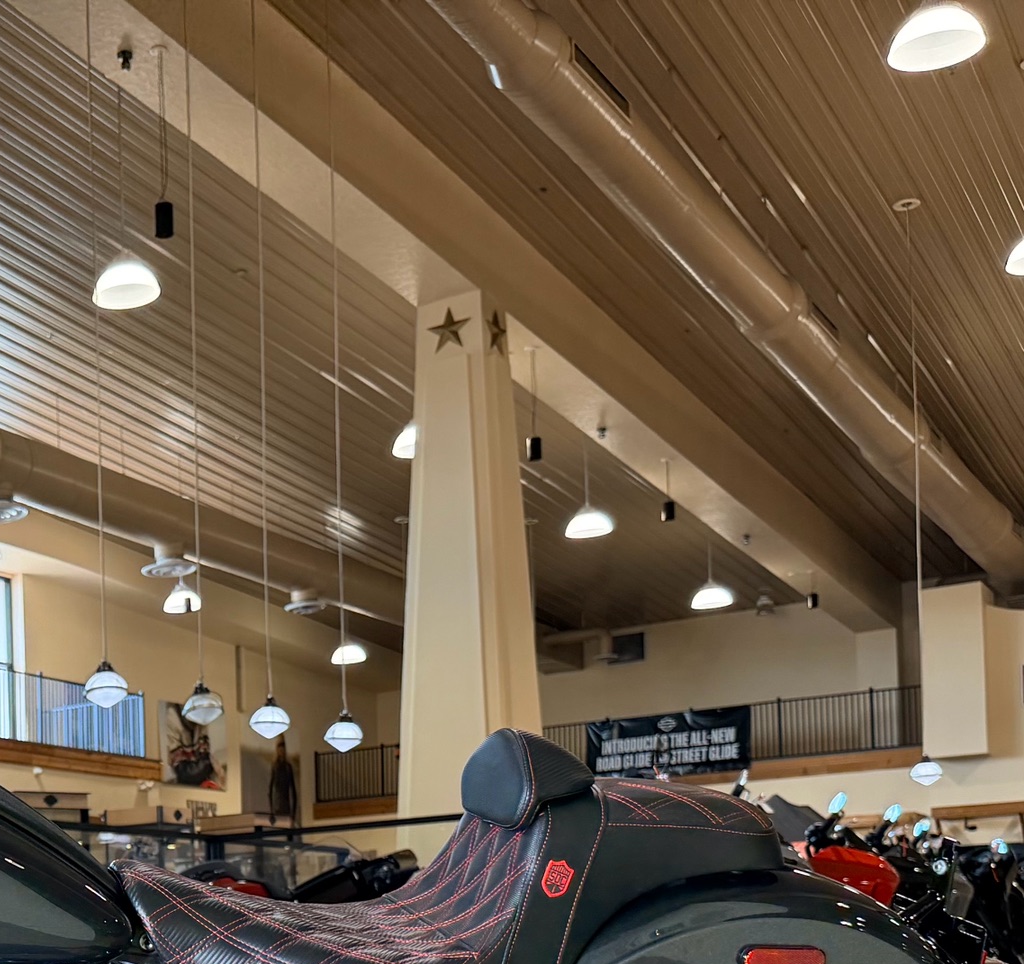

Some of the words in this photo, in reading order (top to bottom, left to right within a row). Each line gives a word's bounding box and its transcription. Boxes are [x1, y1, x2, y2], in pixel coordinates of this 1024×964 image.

[670, 731, 689, 748] THE
[690, 726, 737, 747] ALL-NEW
[595, 756, 622, 772] ROAD
[623, 752, 653, 769] GLIDE
[670, 748, 708, 765] STREET
[709, 742, 740, 761] GLIDE
